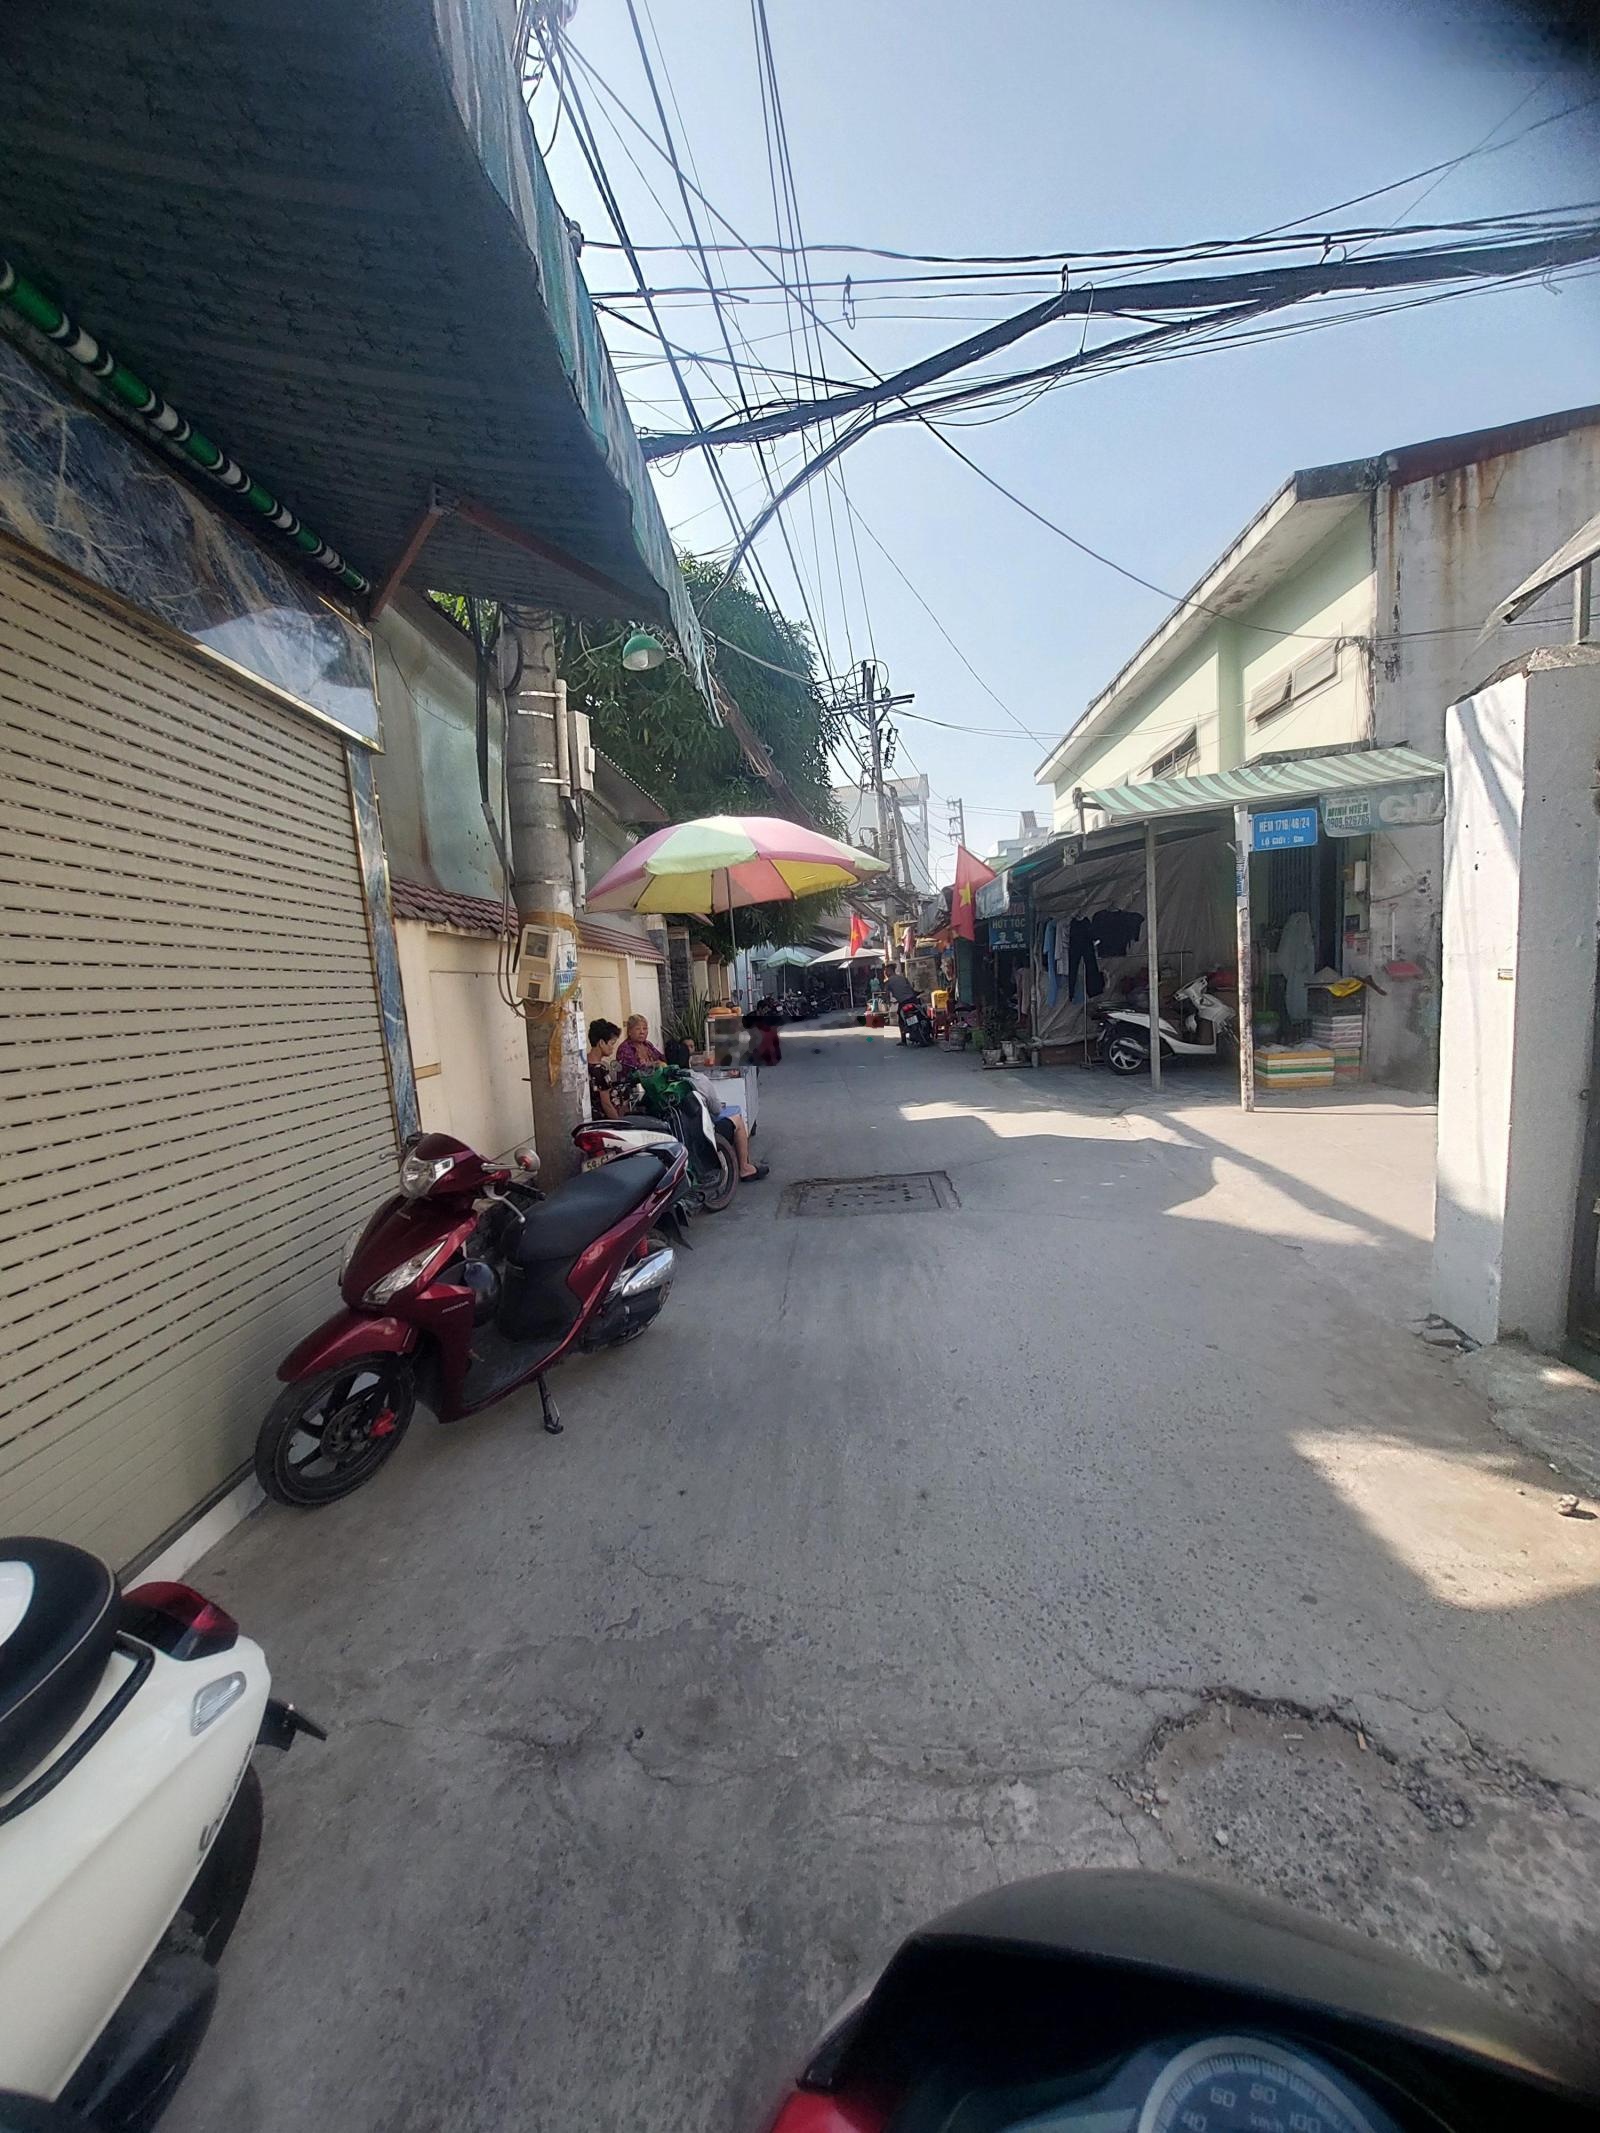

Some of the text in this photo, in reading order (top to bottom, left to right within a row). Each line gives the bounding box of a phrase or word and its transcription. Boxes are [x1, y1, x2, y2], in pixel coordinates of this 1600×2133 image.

[1210, 2087, 1236, 2108] 60
[1250, 2083, 1276, 2104] 80
[1182, 2110, 1207, 2132] 40
[1289, 2112, 1322, 2133] 100
